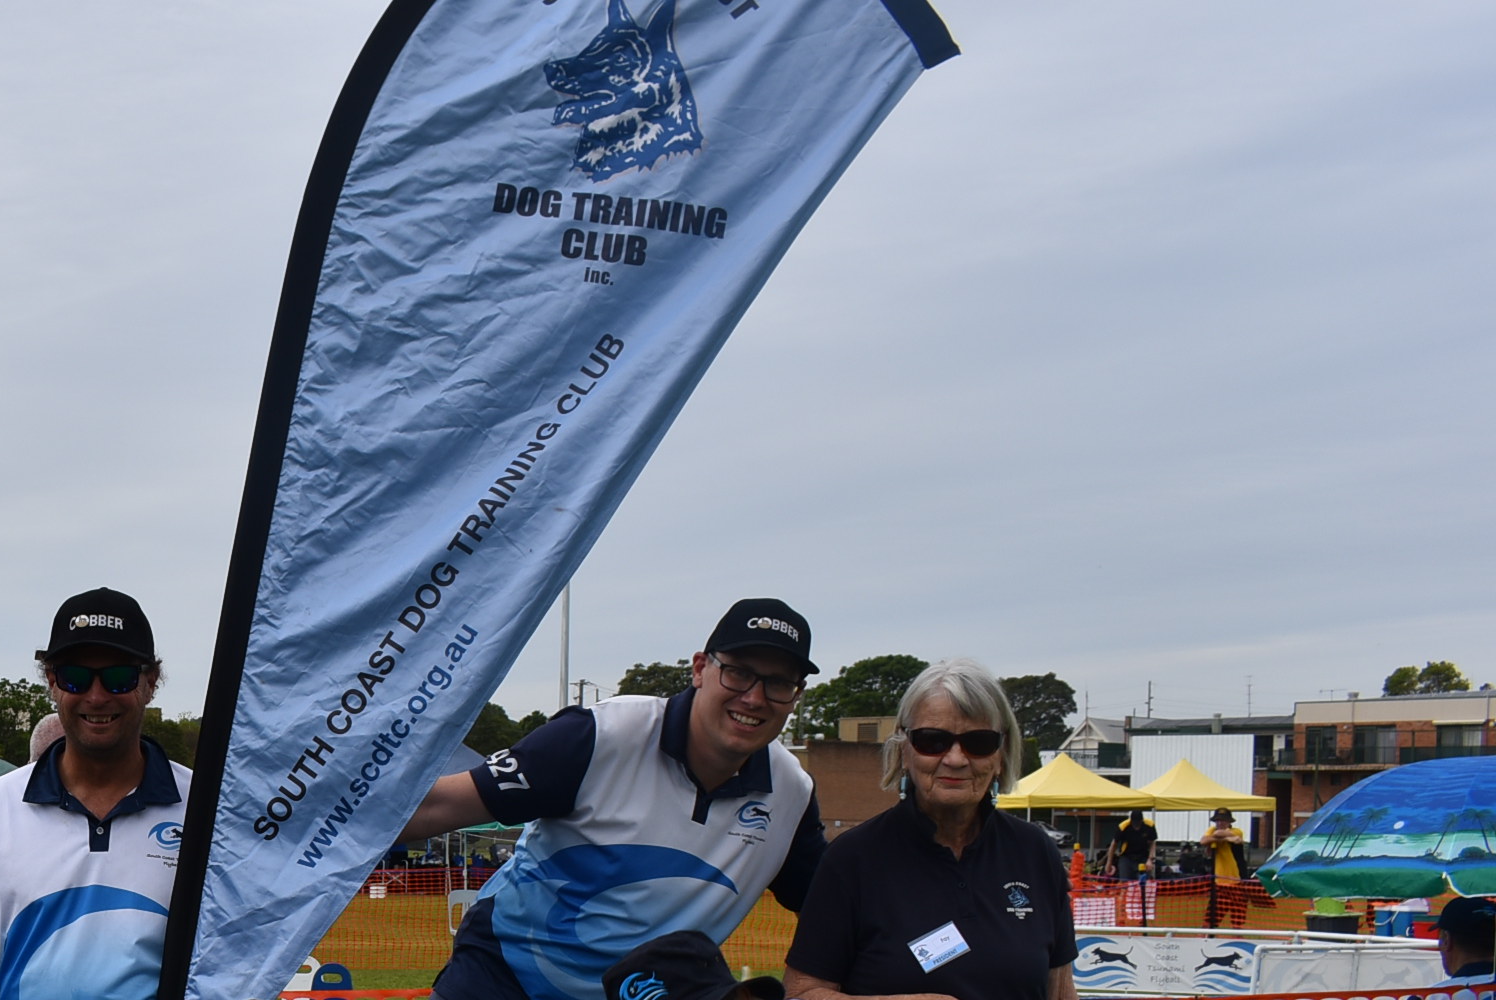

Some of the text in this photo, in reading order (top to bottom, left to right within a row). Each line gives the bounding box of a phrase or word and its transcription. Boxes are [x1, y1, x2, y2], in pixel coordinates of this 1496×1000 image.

[492, 182, 729, 240] DOG TRAINING
[560, 227, 649, 267] CLUB
[583, 266, 615, 287] inc.
[253, 332, 626, 841] SOUTH COAST DOG TRAINING CLUB
[69, 614, 124, 631] COBBER
[746, 616, 799, 642] COBBER
[296, 623, 479, 870] www.scdtc.org.au
